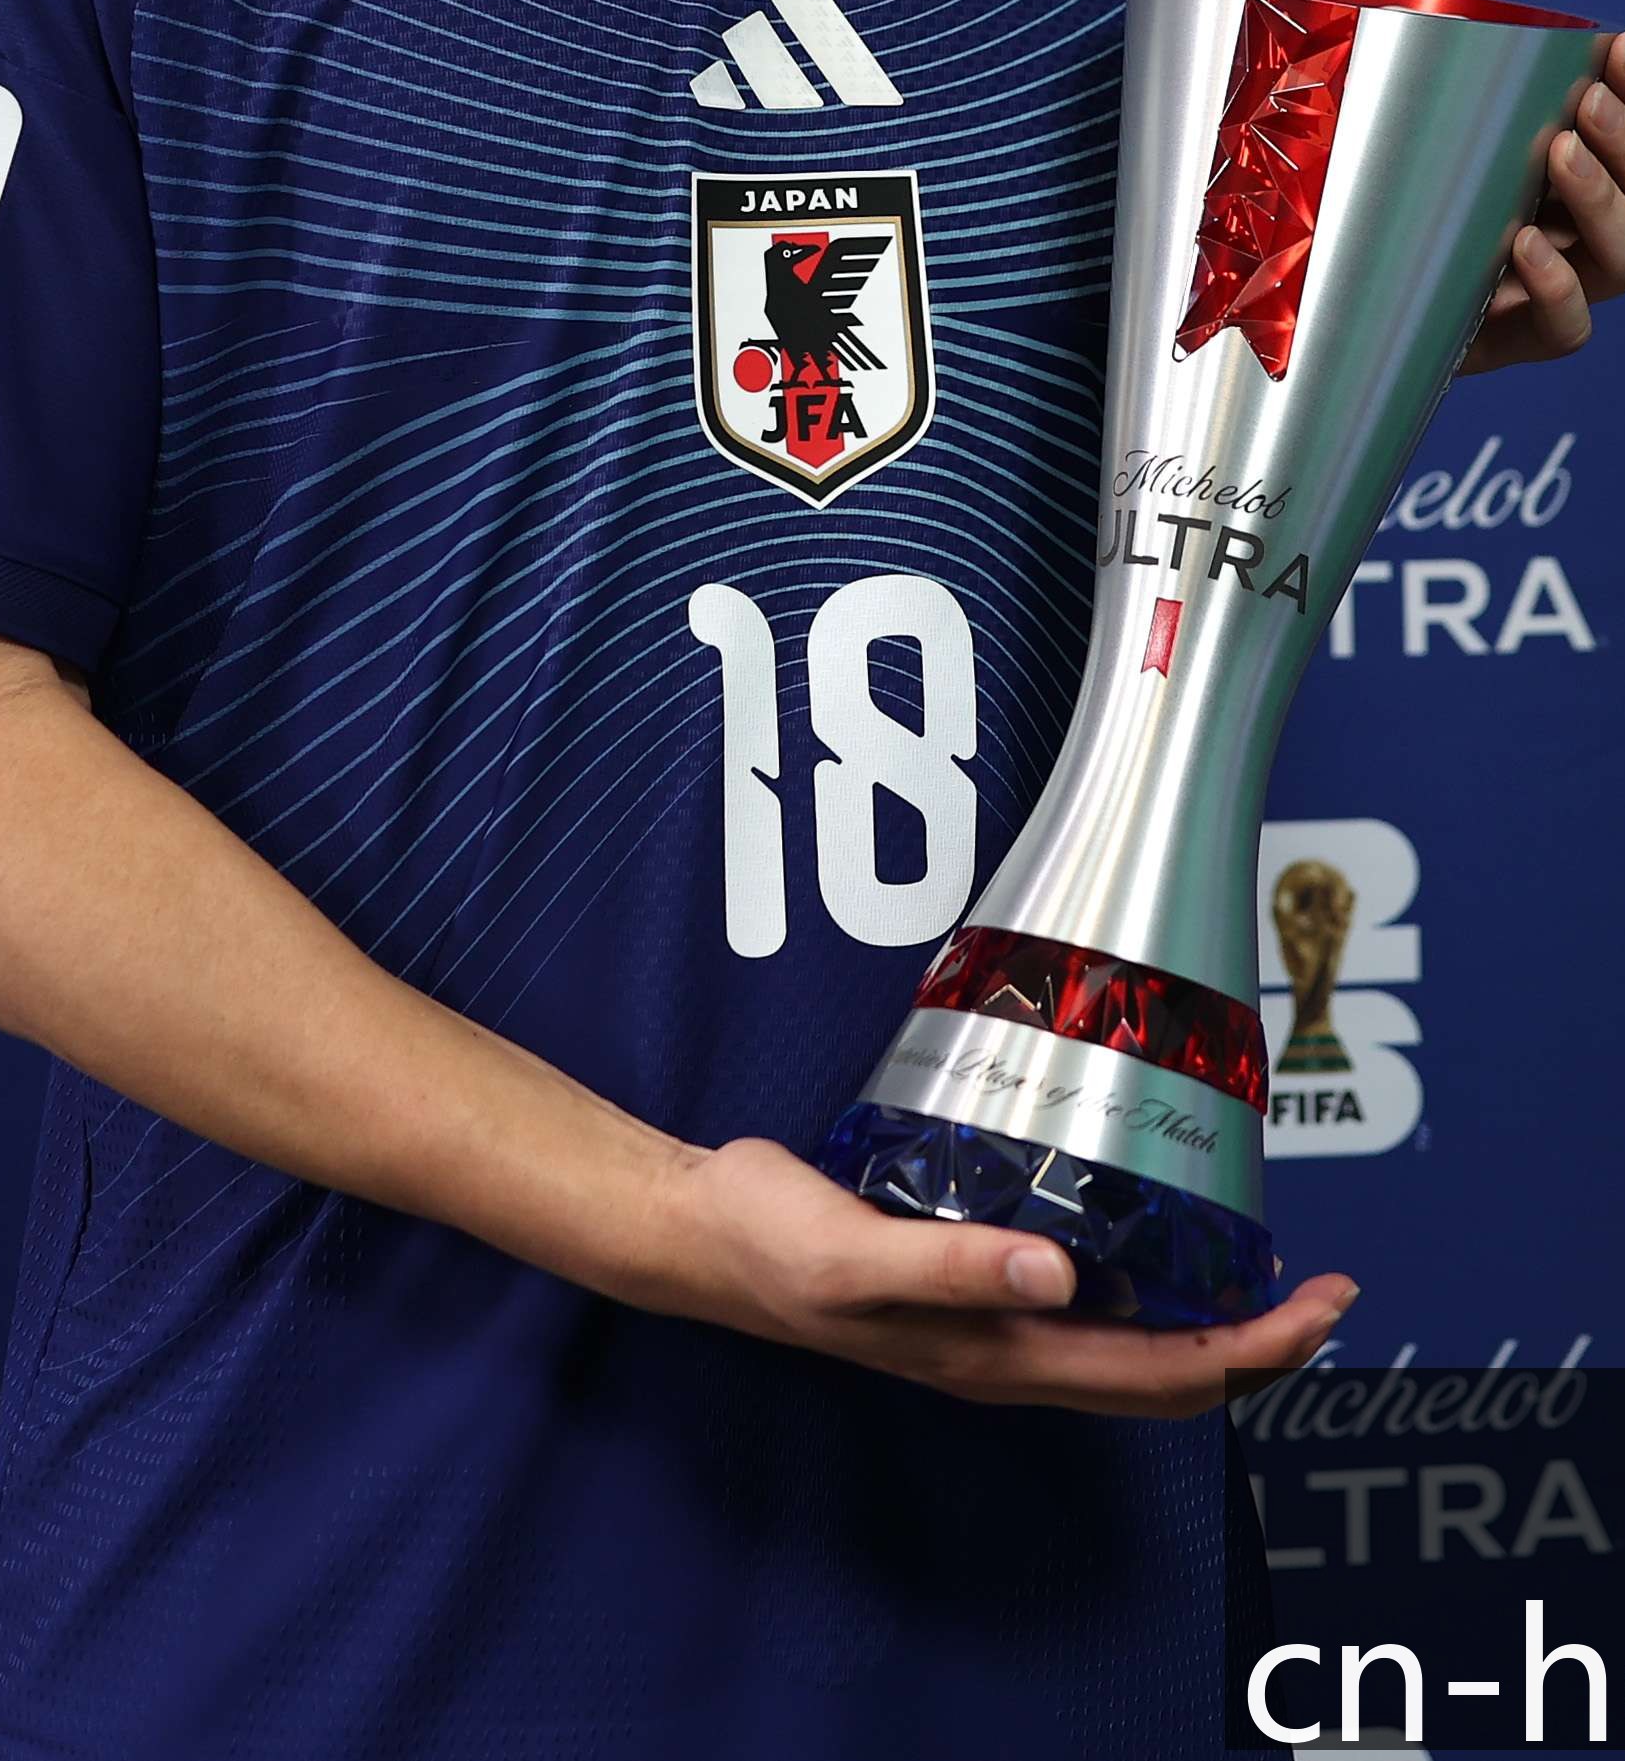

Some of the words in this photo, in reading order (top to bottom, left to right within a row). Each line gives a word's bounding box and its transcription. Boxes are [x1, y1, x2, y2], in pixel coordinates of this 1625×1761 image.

[740, 187, 859, 213] JAPAN
[761, 393, 868, 444] JFA
[1112, 449, 1293, 520] Michelob
[1329, 555, 1598, 660] TRA
[687, 573, 978, 959] 18
[1124, 1097, 1219, 1154] Match
[1270, 1086, 1366, 1126] FIFA
[1248, 1459, 1613, 1570] LTRA
